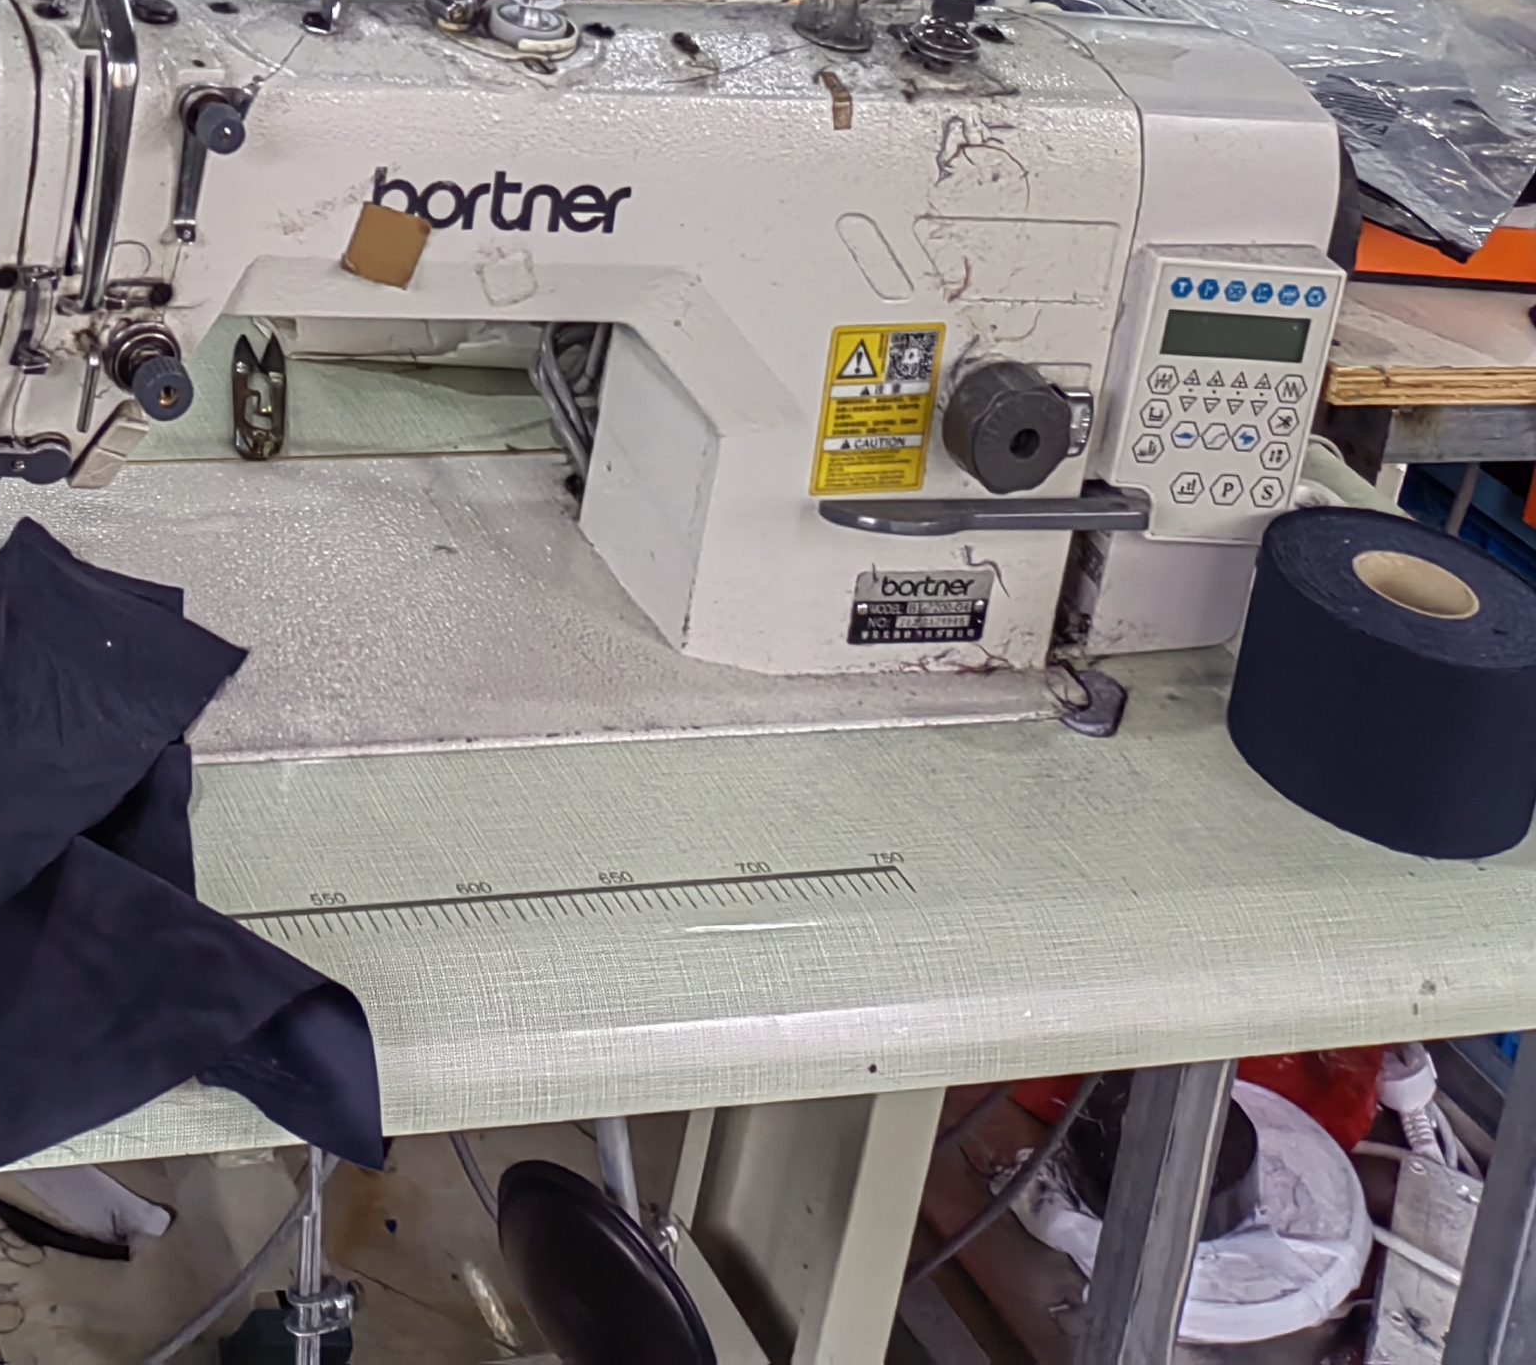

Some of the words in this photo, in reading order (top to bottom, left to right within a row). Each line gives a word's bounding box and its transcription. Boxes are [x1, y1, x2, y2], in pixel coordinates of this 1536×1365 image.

[372, 166, 632, 234] bortner
[854, 436, 906, 450] CAUTION
[1221, 482, 1234, 498] P
[1261, 485, 1275, 501] S
[881, 575, 975, 597] bortner
[310, 892, 347, 906] 550
[456, 881, 492, 895] 600
[598, 871, 634, 885] 650
[735, 861, 772, 874] 700
[866, 852, 905, 866] 750
